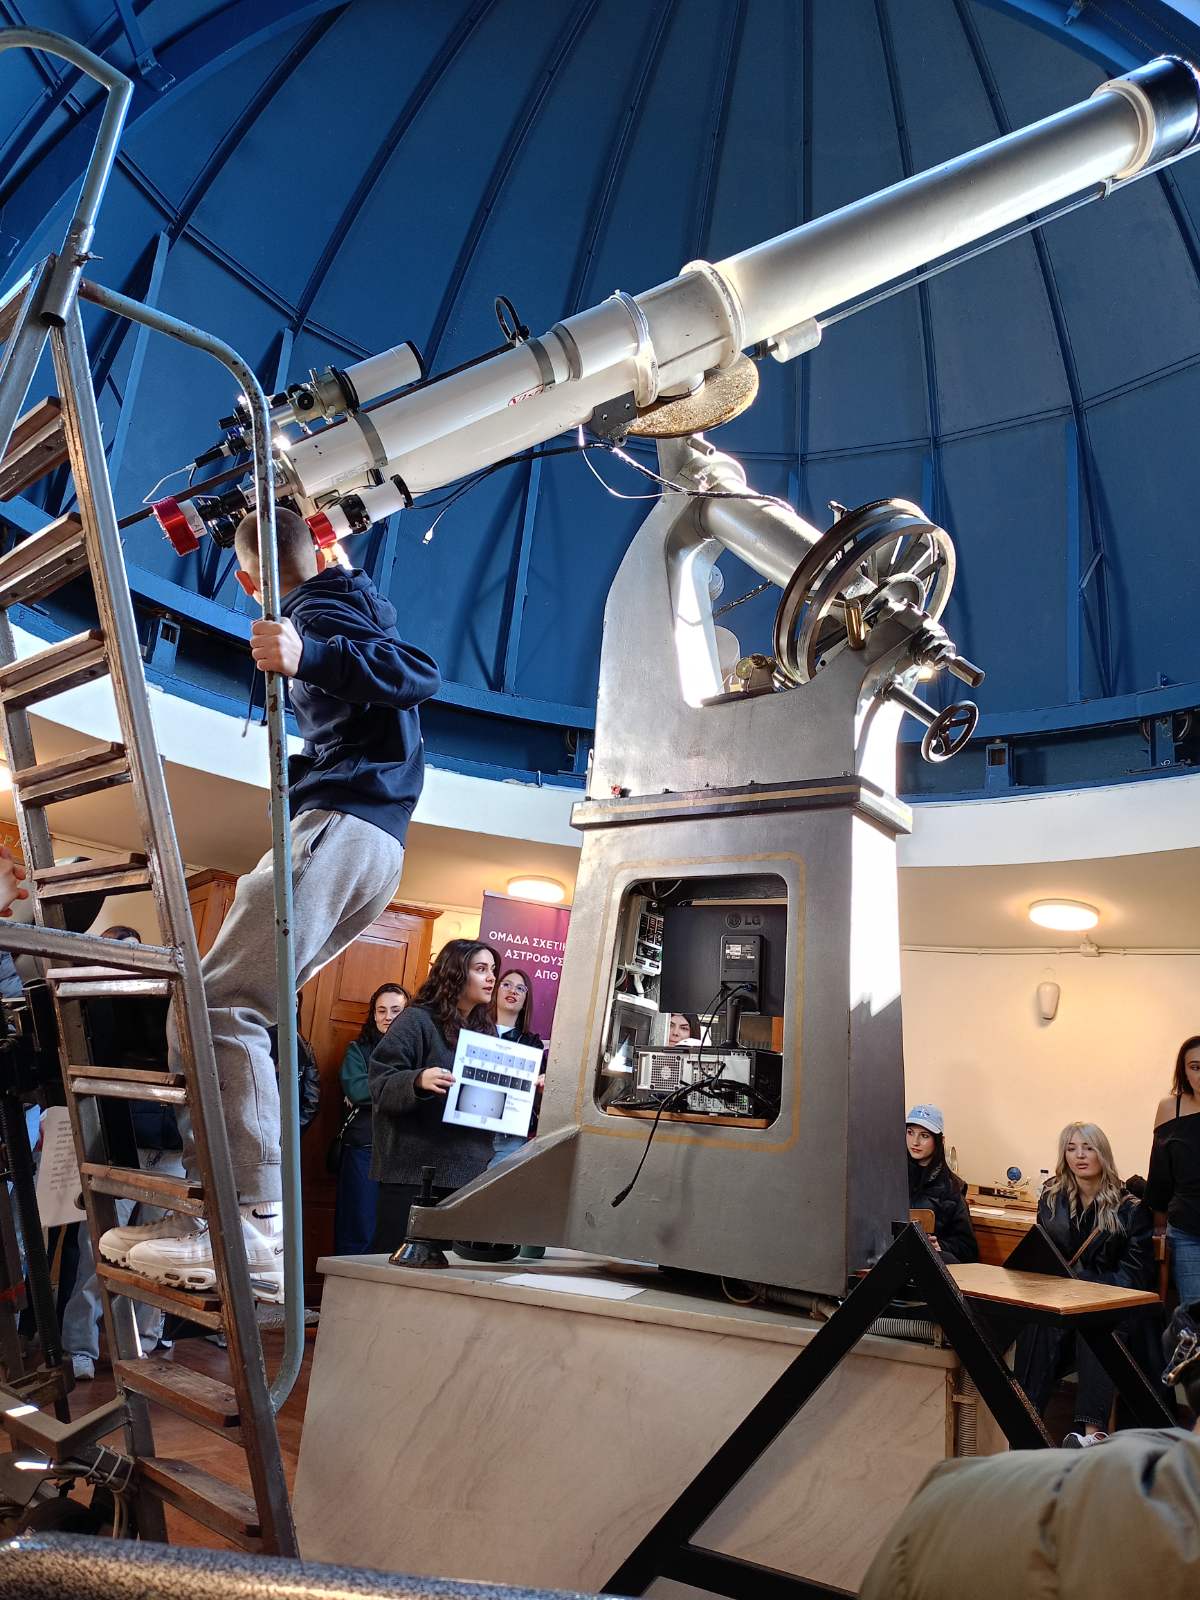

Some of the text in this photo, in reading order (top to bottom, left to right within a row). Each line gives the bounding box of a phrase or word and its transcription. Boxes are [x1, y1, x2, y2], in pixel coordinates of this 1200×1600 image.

[744, 914, 761, 926] LG
[488, 930, 530, 946] ΟΜΑΔΑ
[504, 949, 565, 967] ΑΣΤΡΟΦΥΣ
[534, 969, 559, 981] ΑΠΘ
